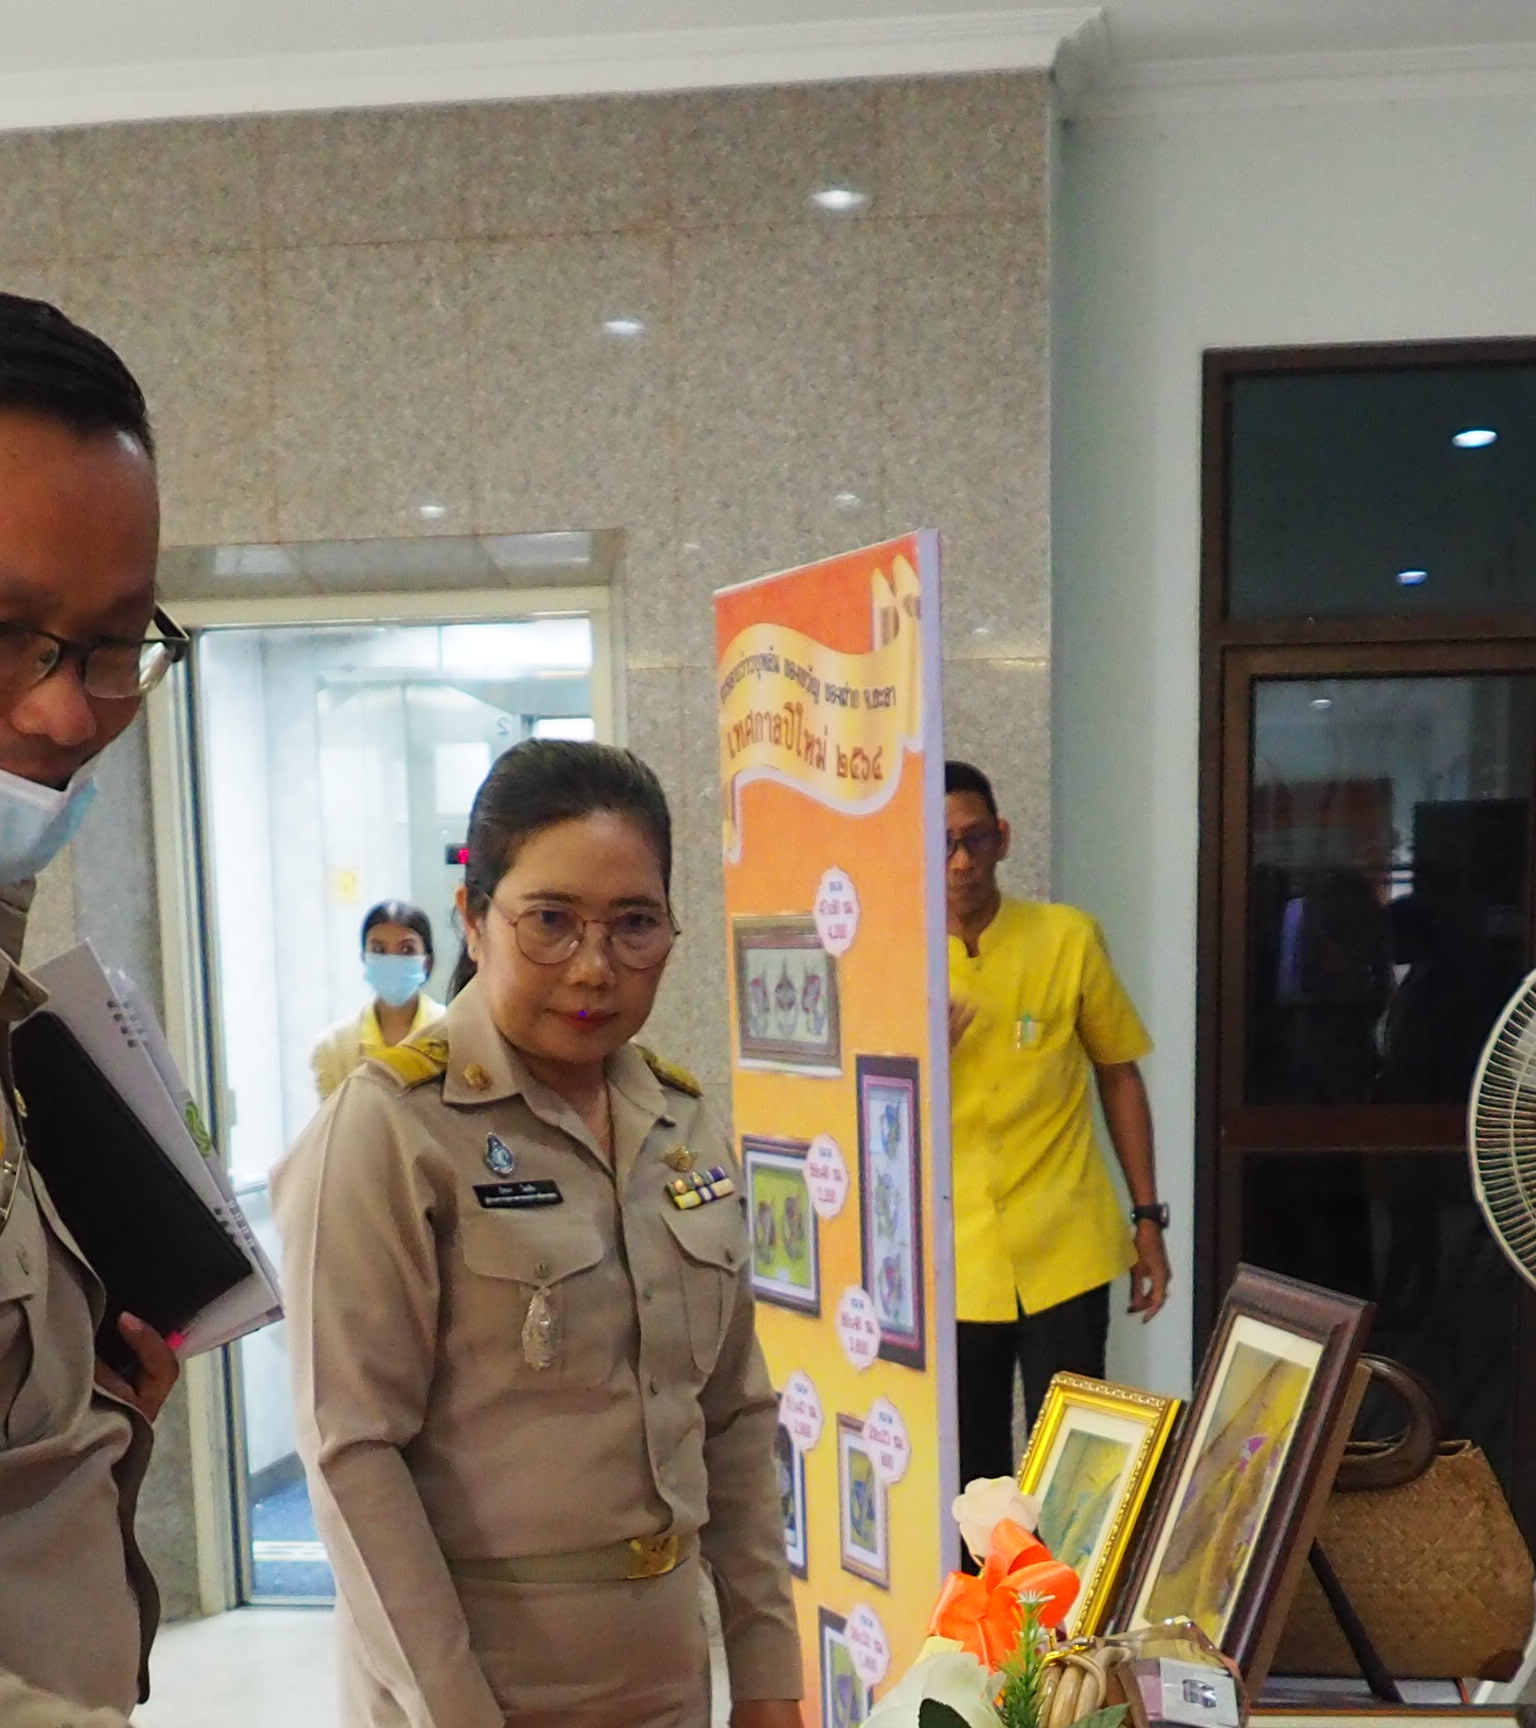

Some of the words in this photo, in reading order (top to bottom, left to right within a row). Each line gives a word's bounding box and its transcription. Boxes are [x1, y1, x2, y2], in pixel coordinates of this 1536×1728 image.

[727, 700, 829, 772] เทศกาลปีใหม่
